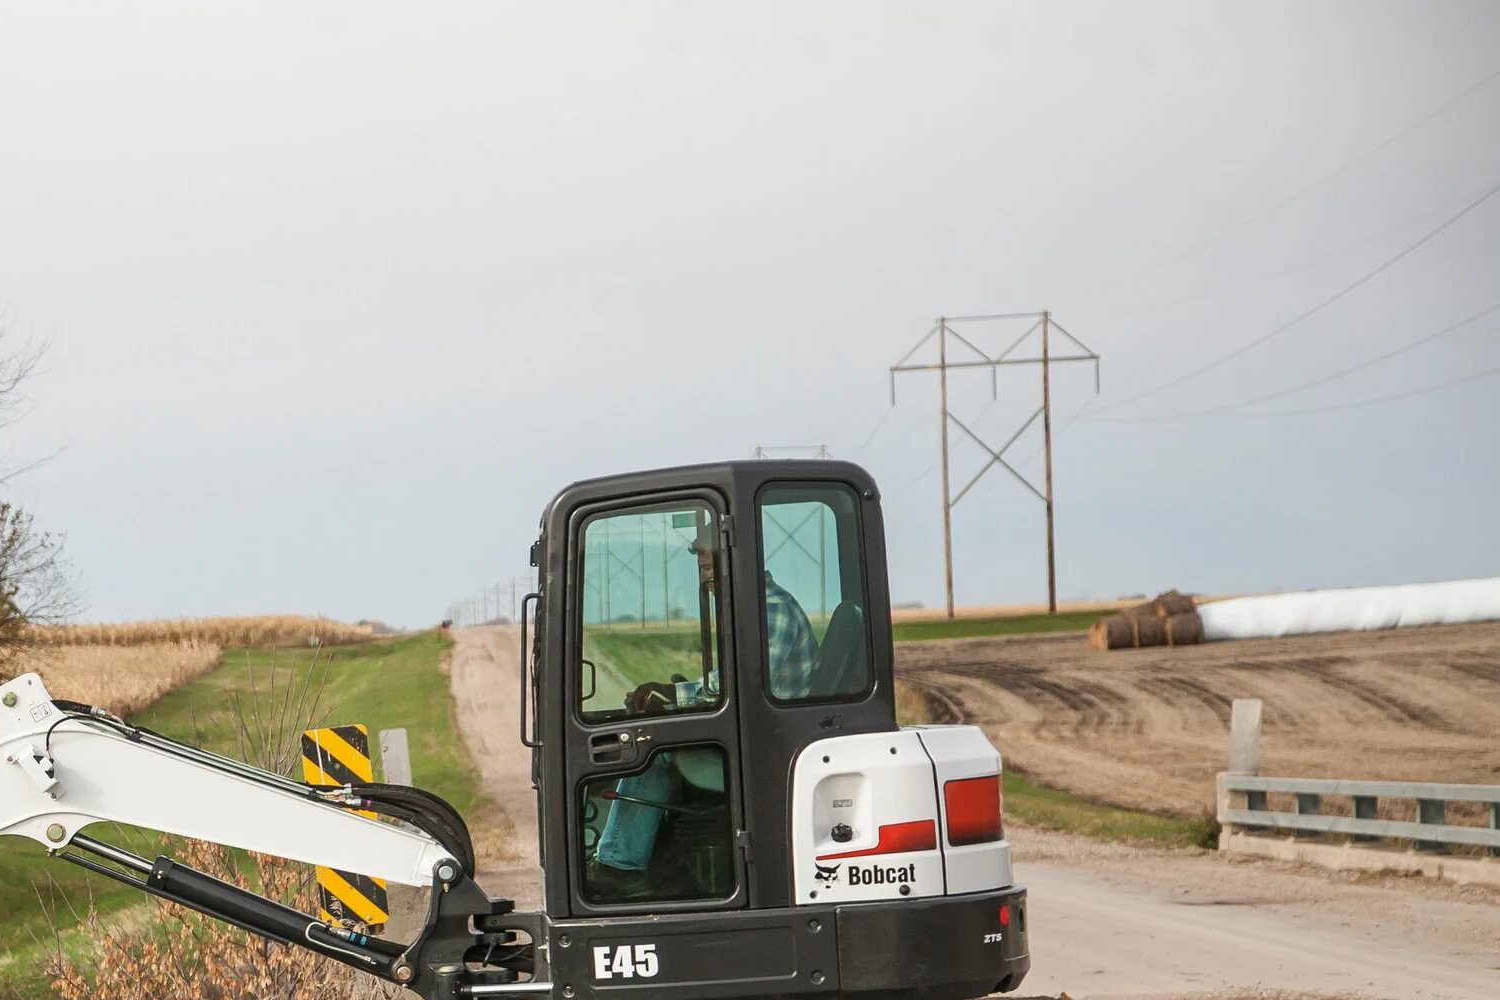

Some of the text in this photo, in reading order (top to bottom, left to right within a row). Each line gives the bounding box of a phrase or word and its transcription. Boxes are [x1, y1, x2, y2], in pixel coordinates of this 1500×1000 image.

[848, 863, 916, 885] Bobcat
[984, 932, 1002, 943] ZTS
[593, 944, 659, 979] E45
